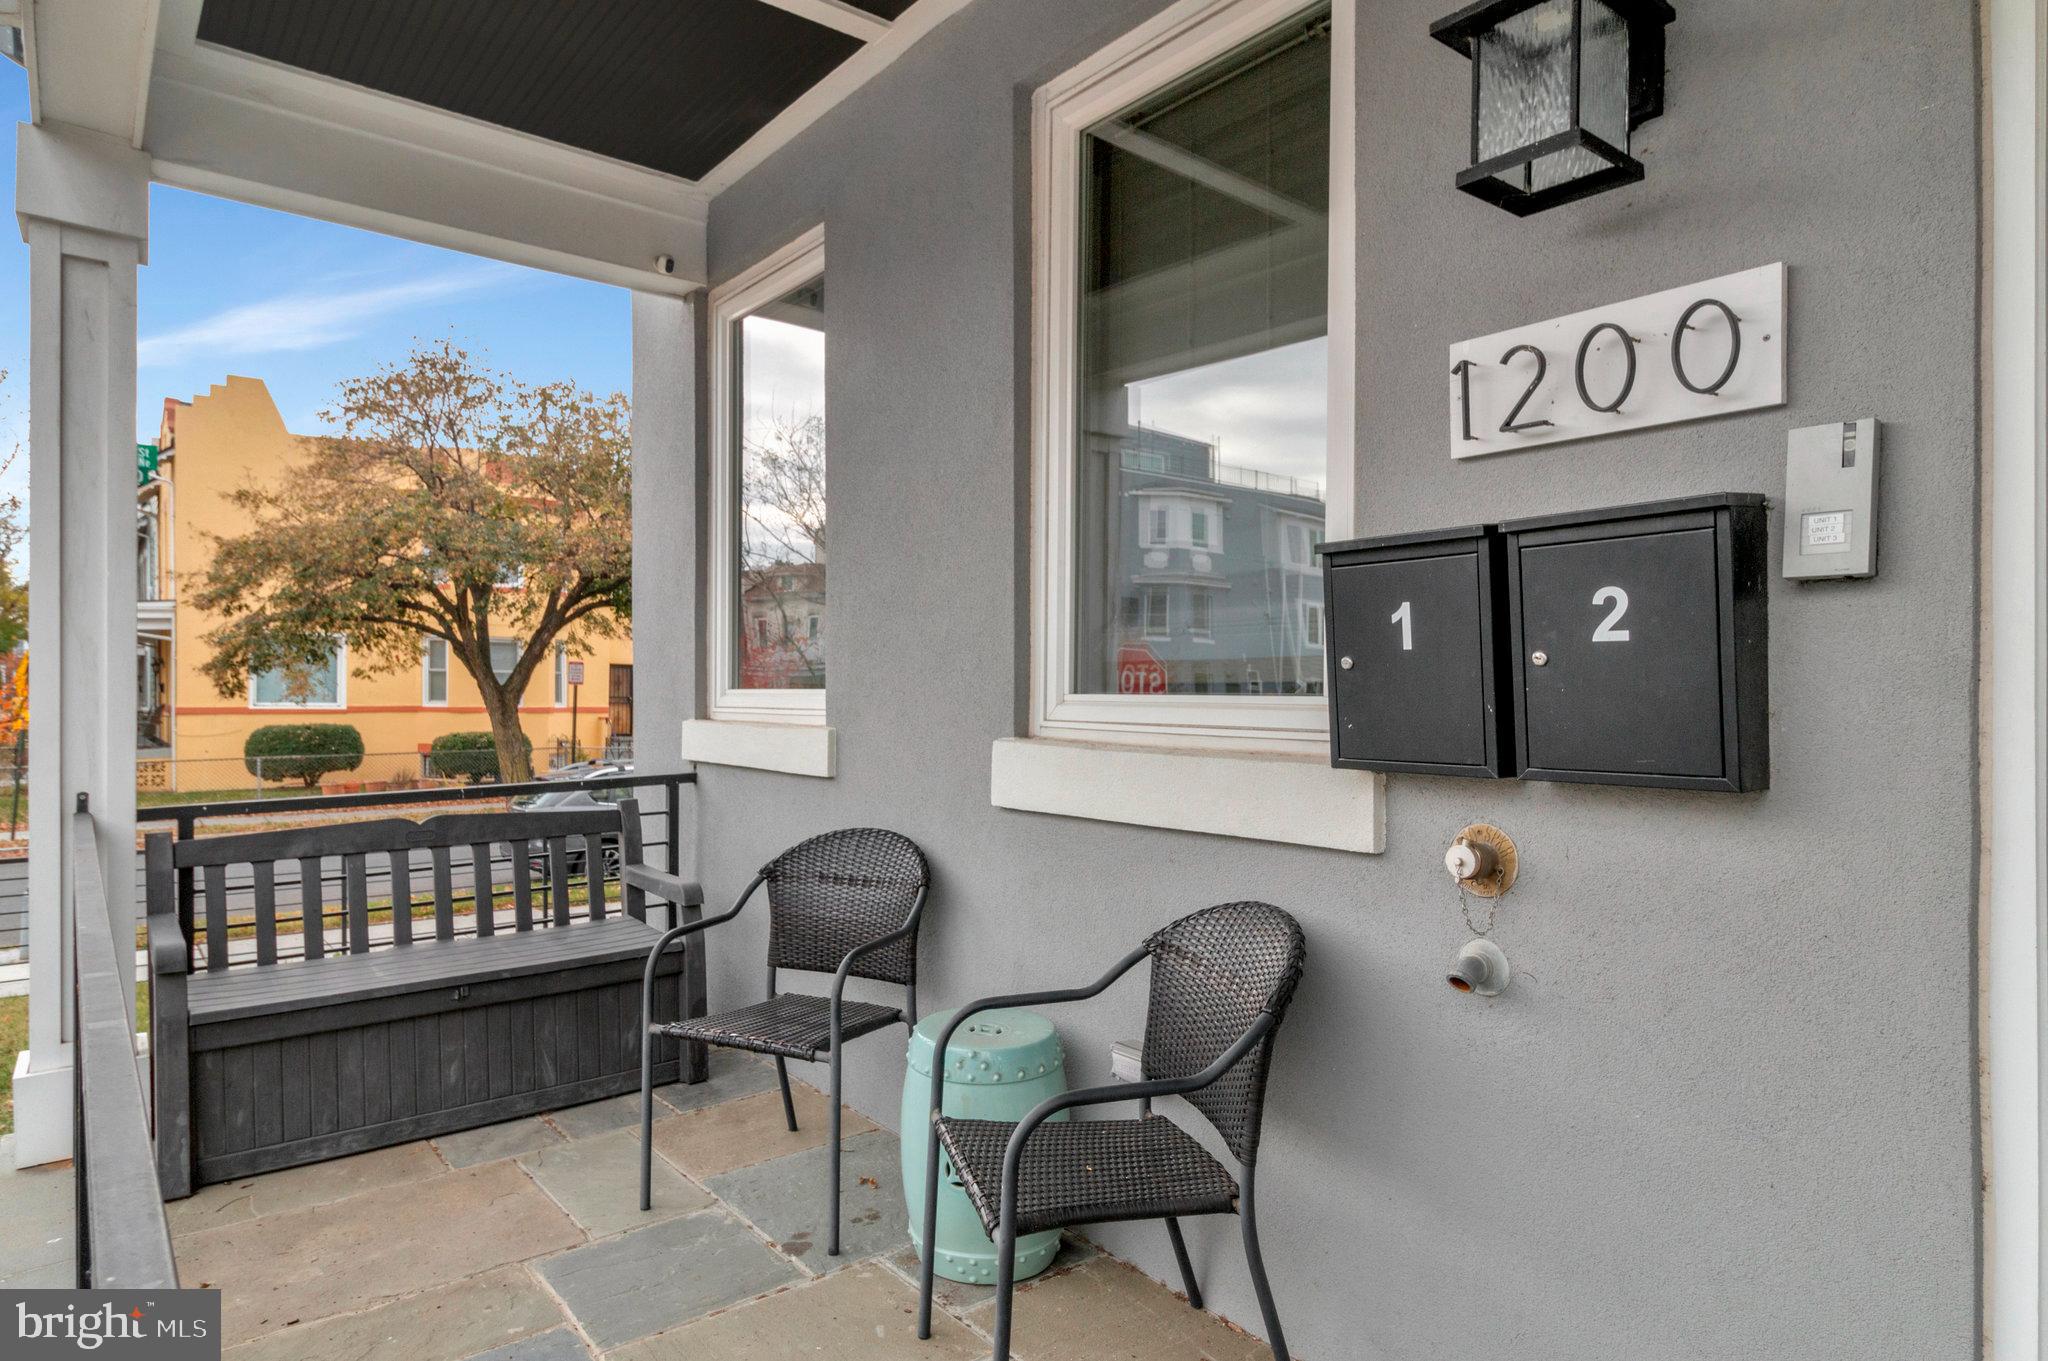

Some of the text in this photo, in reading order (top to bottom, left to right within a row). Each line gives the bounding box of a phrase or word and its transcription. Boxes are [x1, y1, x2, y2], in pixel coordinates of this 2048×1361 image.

[1451, 298, 1741, 440] 1200
[1391, 601, 1412, 650] 1
[1591, 586, 1630, 642] 2
